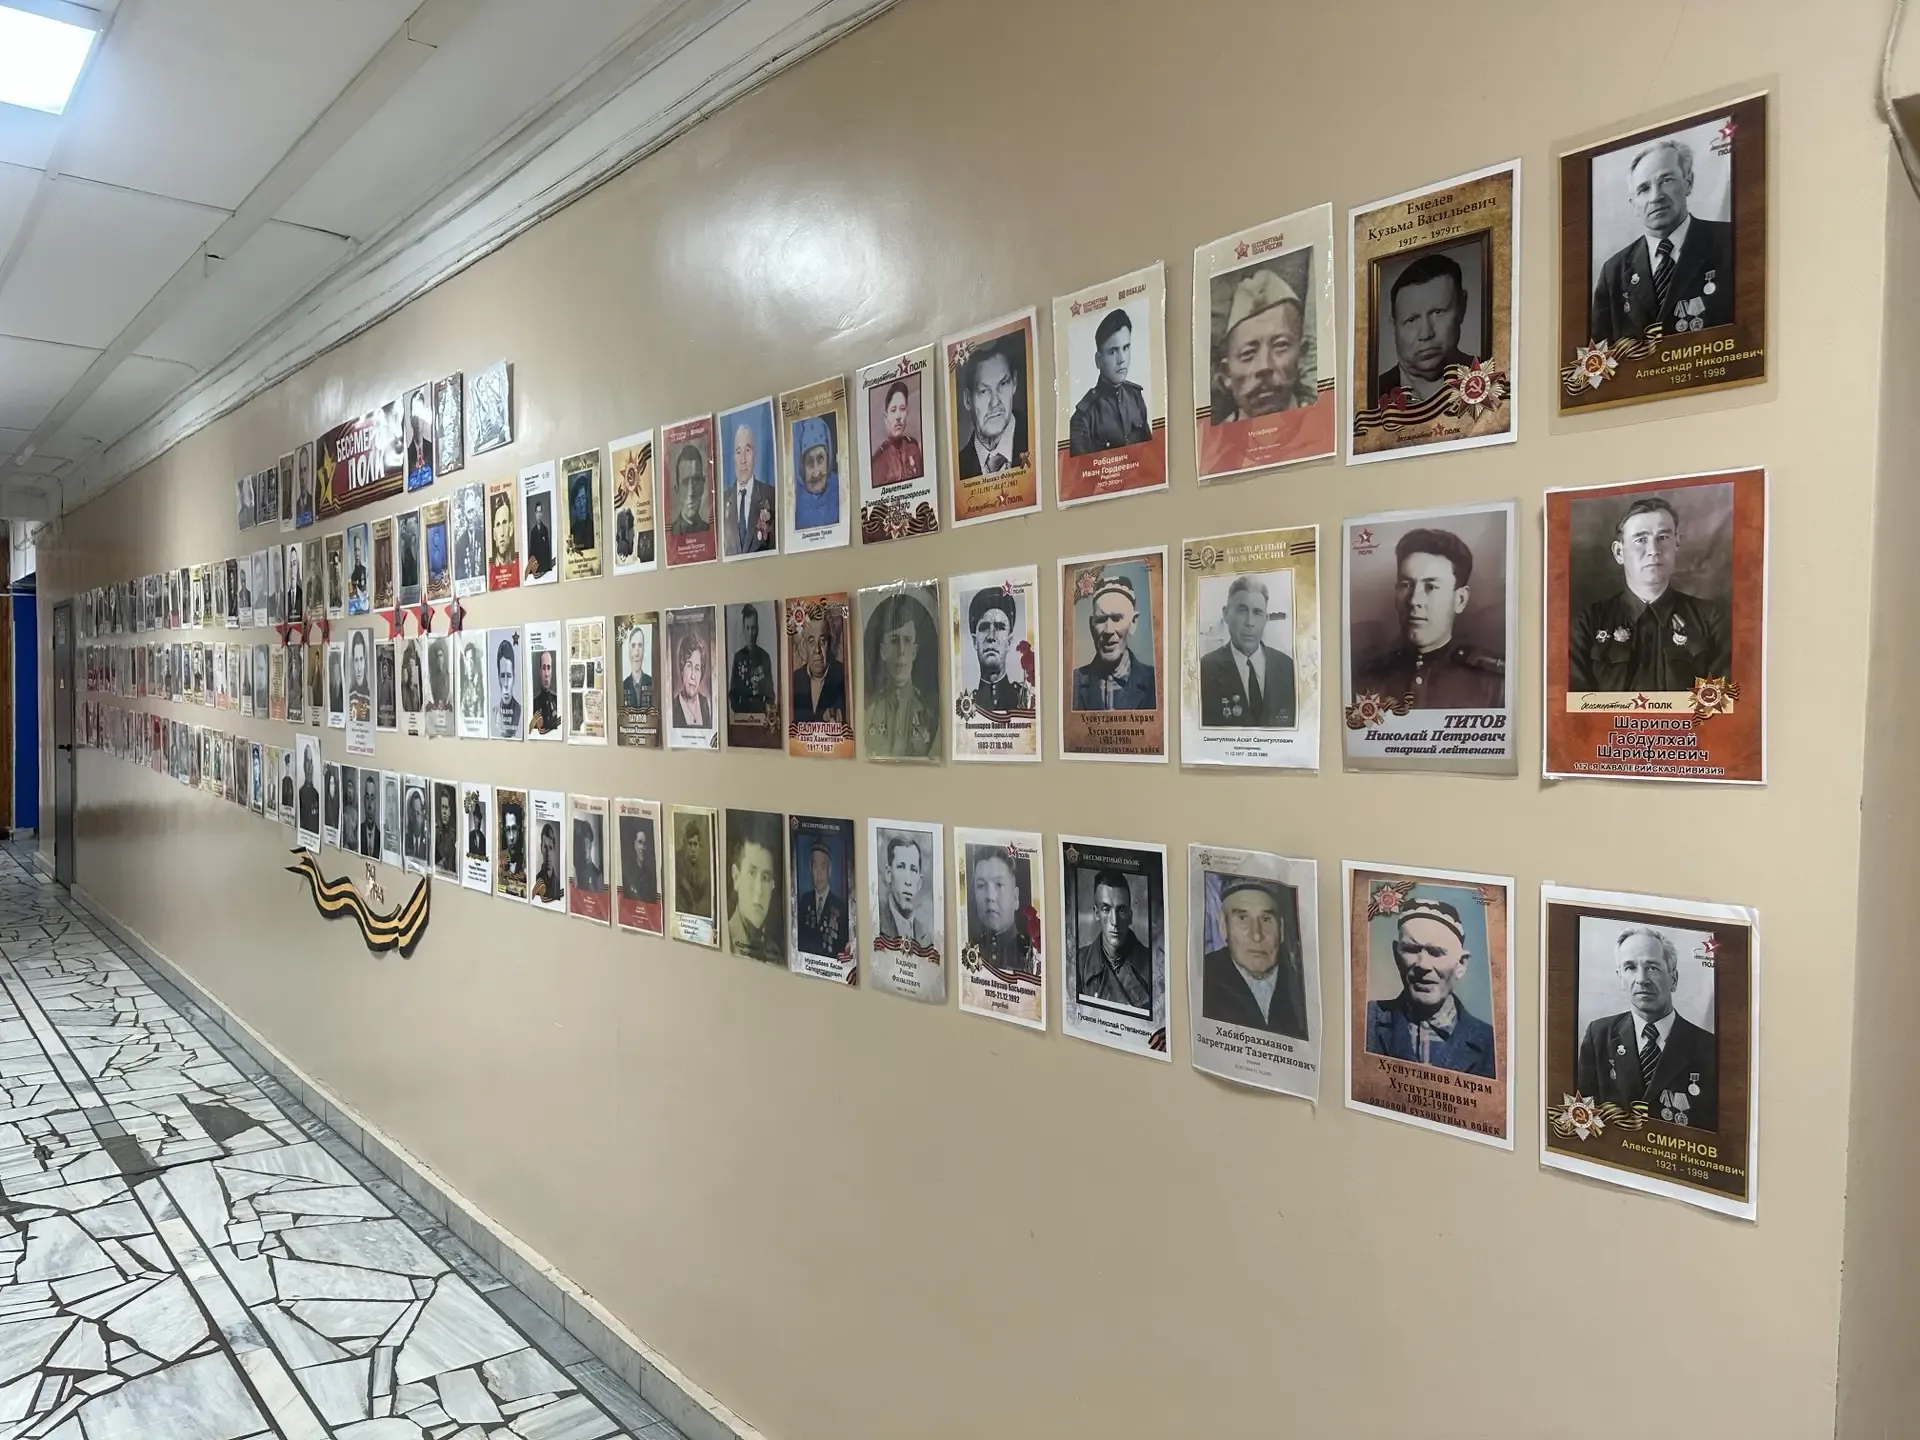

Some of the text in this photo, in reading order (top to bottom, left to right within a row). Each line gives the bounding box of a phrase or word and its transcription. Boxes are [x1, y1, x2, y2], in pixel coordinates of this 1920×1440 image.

[1407, 193, 1454, 215] Емелев
[1368, 197, 1497, 242] Кузьма Васильевич
[1398, 235, 1418, 248] 1917
[1661, 339, 1735, 362] СМИРНОВ
[909, 359, 927, 373] ПОЛК
[1635, 348, 1763, 379] Александр Николаевич
[1670, 373, 1692, 384] 1921
[1703, 367, 1726, 379] 1998
[1093, 454, 1128, 466] Рабцевич
[348, 449, 385, 490] ПОЛК
[1082, 461, 1140, 478] Иван Гордеевич
[1226, 542, 1286, 555] БЕССМЕРТНЫЙ
[1249, 551, 1284, 561] РОССИИ
[1648, 702, 1672, 710] ПОЛК
[1080, 714, 1155, 725] Хуснутдинов Акрам
[1444, 714, 1507, 728] ТИТОВ
[1613, 716, 1692, 732] Шарипов
[1088, 727, 1145, 736] Хуснутдинович
[1364, 730, 1505, 744] Николай Петрович
[1608, 731, 1696, 748] Габдулхай
[1384, 745, 1505, 755] старший лейтенант
[1597, 745, 1709, 762] Шарифиевич
[1600, 763, 1676, 774] КАВАЛЕРИЙСКАЯ
[1678, 766, 1724, 776] ДИВИЗИЯ
[1097, 1018, 1120, 1030] Николай
[1215, 1026, 1294, 1053] Хабибрахманов
[1196, 1033, 1243, 1054] Загретдин
[1244, 1046, 1316, 1072] Тазетдинович
[1378, 1058, 1493, 1094] Хуснутдинов Акрам
[1389, 1076, 1477, 1108] Хуснутдинович
[1410, 1106, 1468, 1129] сухопутных
[1471, 1120, 1500, 1135] войск
[1647, 1132, 1718, 1158] СМИРНОВ
[1621, 1139, 1745, 1177] Александр Николаевич
[1655, 1159, 1677, 1172] 1921
[1687, 1167, 1709, 1180] 1998
